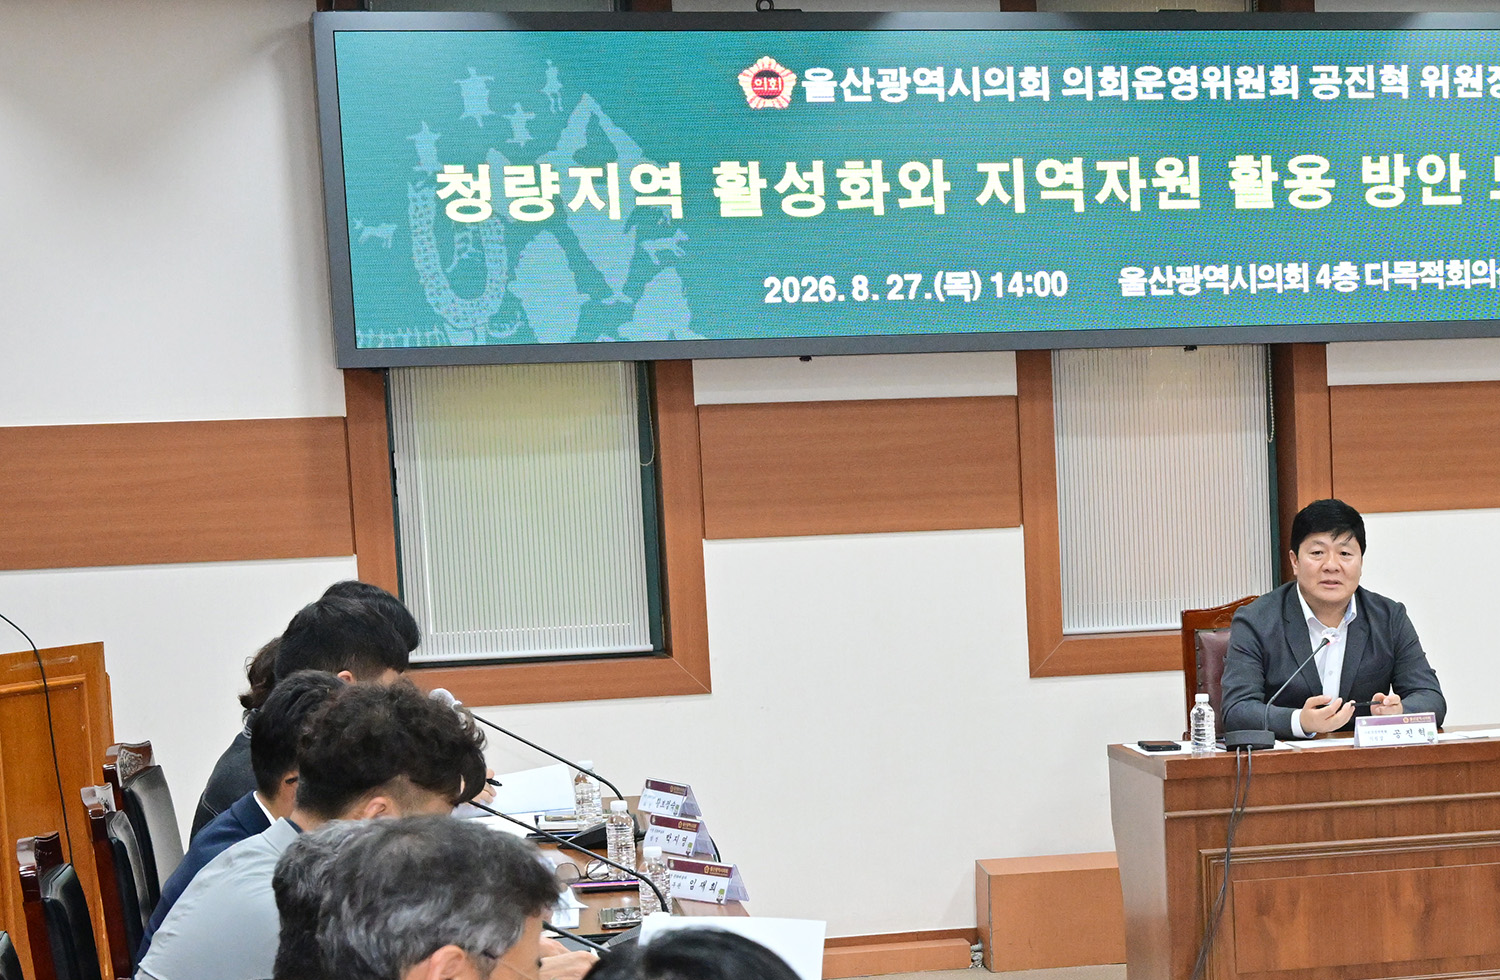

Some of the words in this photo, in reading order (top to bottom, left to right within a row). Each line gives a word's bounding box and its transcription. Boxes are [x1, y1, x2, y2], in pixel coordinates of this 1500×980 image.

[752, 76, 782, 91] 의회
[801, 66, 1050, 103] 울산광역시의회
[1061, 64, 1299, 101] 의회운영위원회
[1309, 64, 1409, 100] 공진혁
[436, 161, 683, 223] 청량지역
[712, 158, 951, 218] 활성화와
[975, 155, 1201, 214] 지역자원
[1228, 154, 1336, 210] 활용
[1361, 152, 1467, 209] 방안
[763, 275, 845, 304] 2026.
[990, 270, 1069, 299] 14:00
[1118, 262, 1310, 297] 울산광역시의회
[1315, 261, 1360, 293] 4층
[1393, 727, 1426, 739] 공진혁
